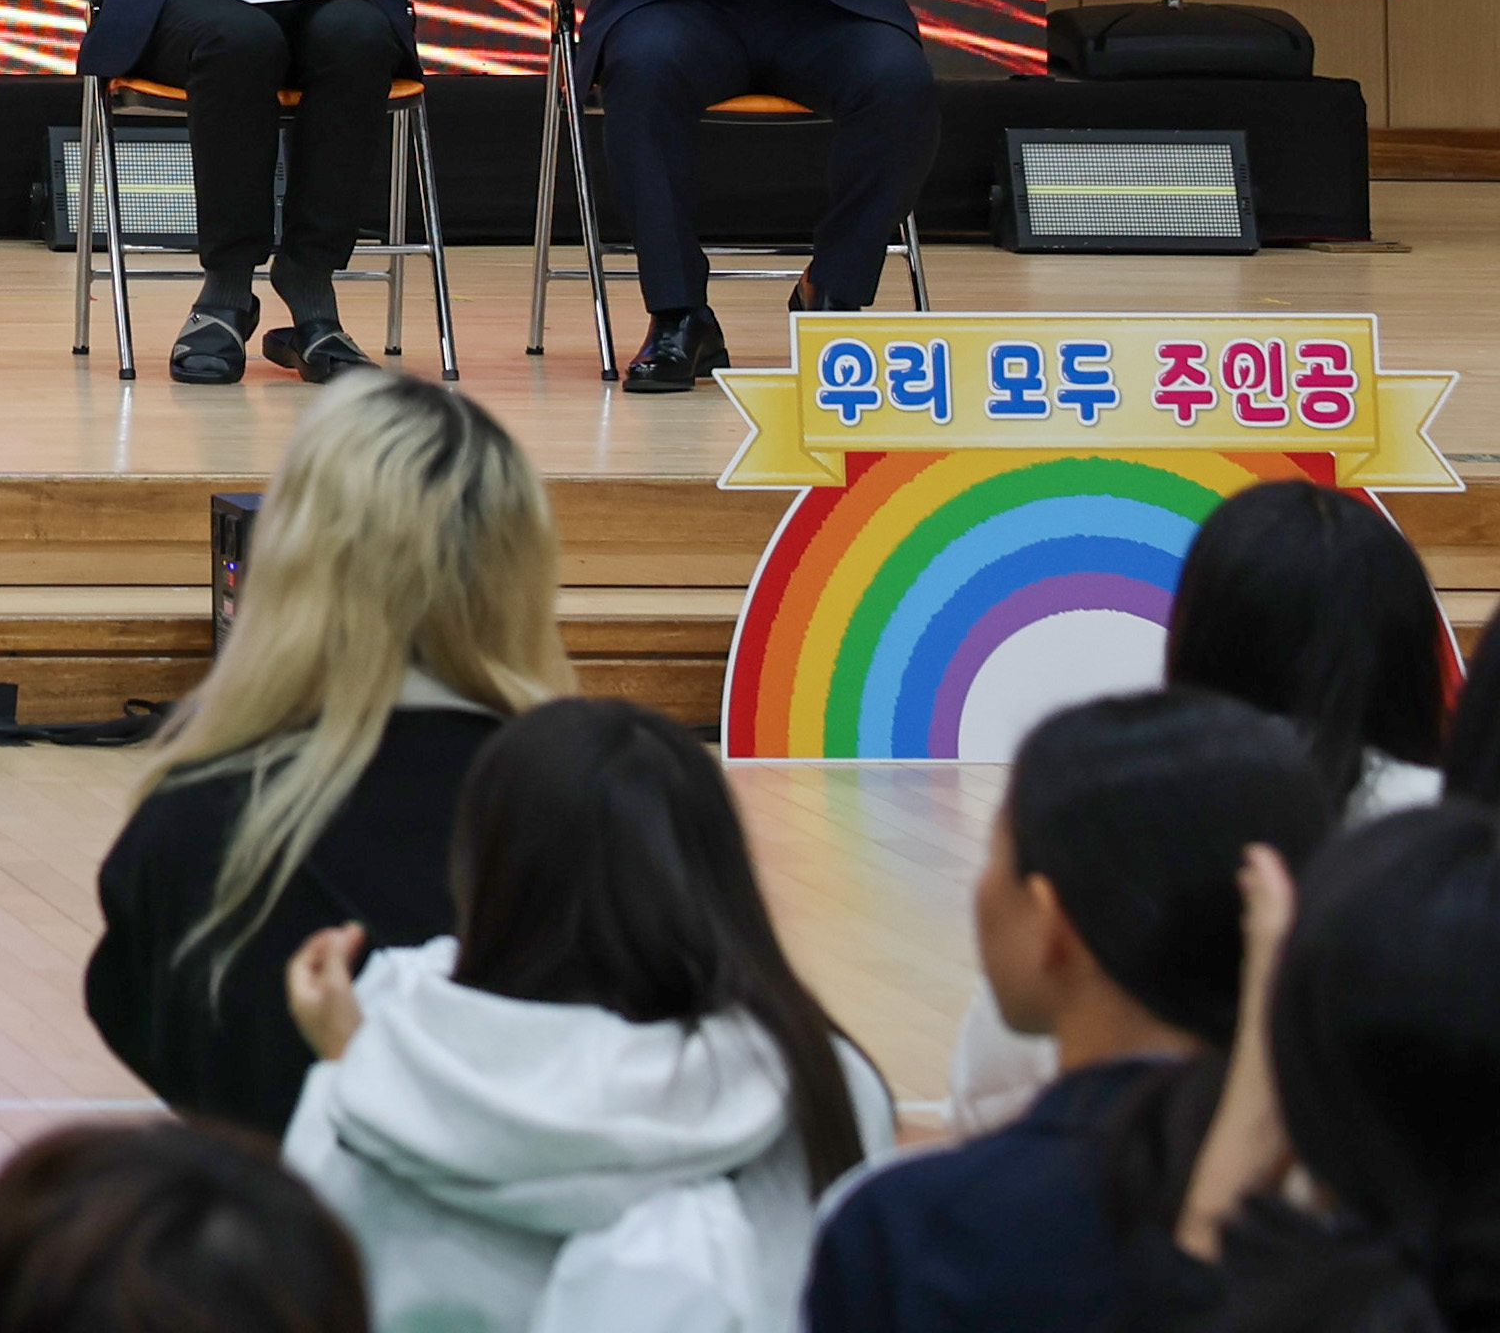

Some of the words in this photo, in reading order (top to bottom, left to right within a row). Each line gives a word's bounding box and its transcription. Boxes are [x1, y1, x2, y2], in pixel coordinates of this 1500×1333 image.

[814, 337, 952, 424] 우리
[984, 337, 1122, 426] 모두
[1150, 336, 1361, 429] 주인공
